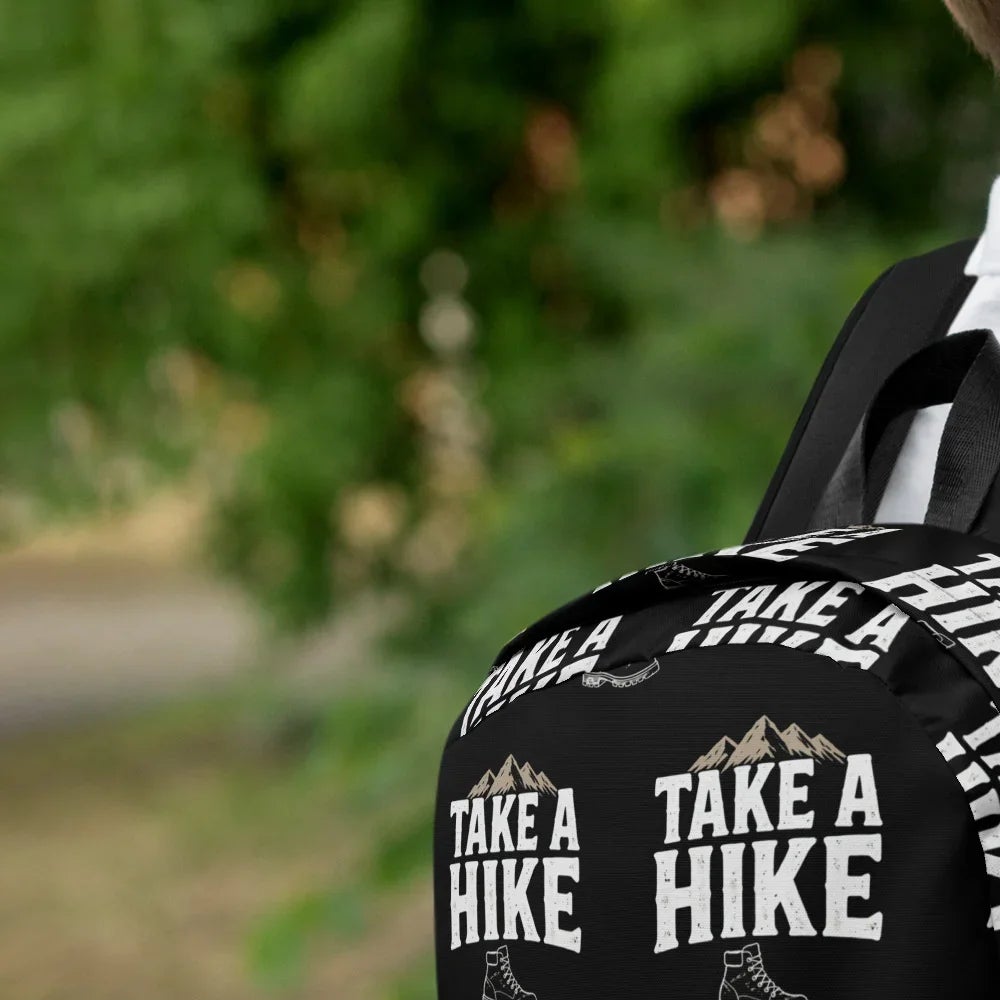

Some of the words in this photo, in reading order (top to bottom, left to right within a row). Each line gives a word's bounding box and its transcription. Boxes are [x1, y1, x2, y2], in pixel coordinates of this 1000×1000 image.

[573, 615, 623, 658] A
[692, 580, 866, 627] TAKE
[844, 603, 910, 653] A
[450, 792, 539, 858] TAKE
[549, 787, 580, 851] A
[654, 758, 815, 844] TAKE
[835, 753, 883, 827] A
[449, 857, 582, 954] HIKE
[653, 833, 883, 954] HIKE
